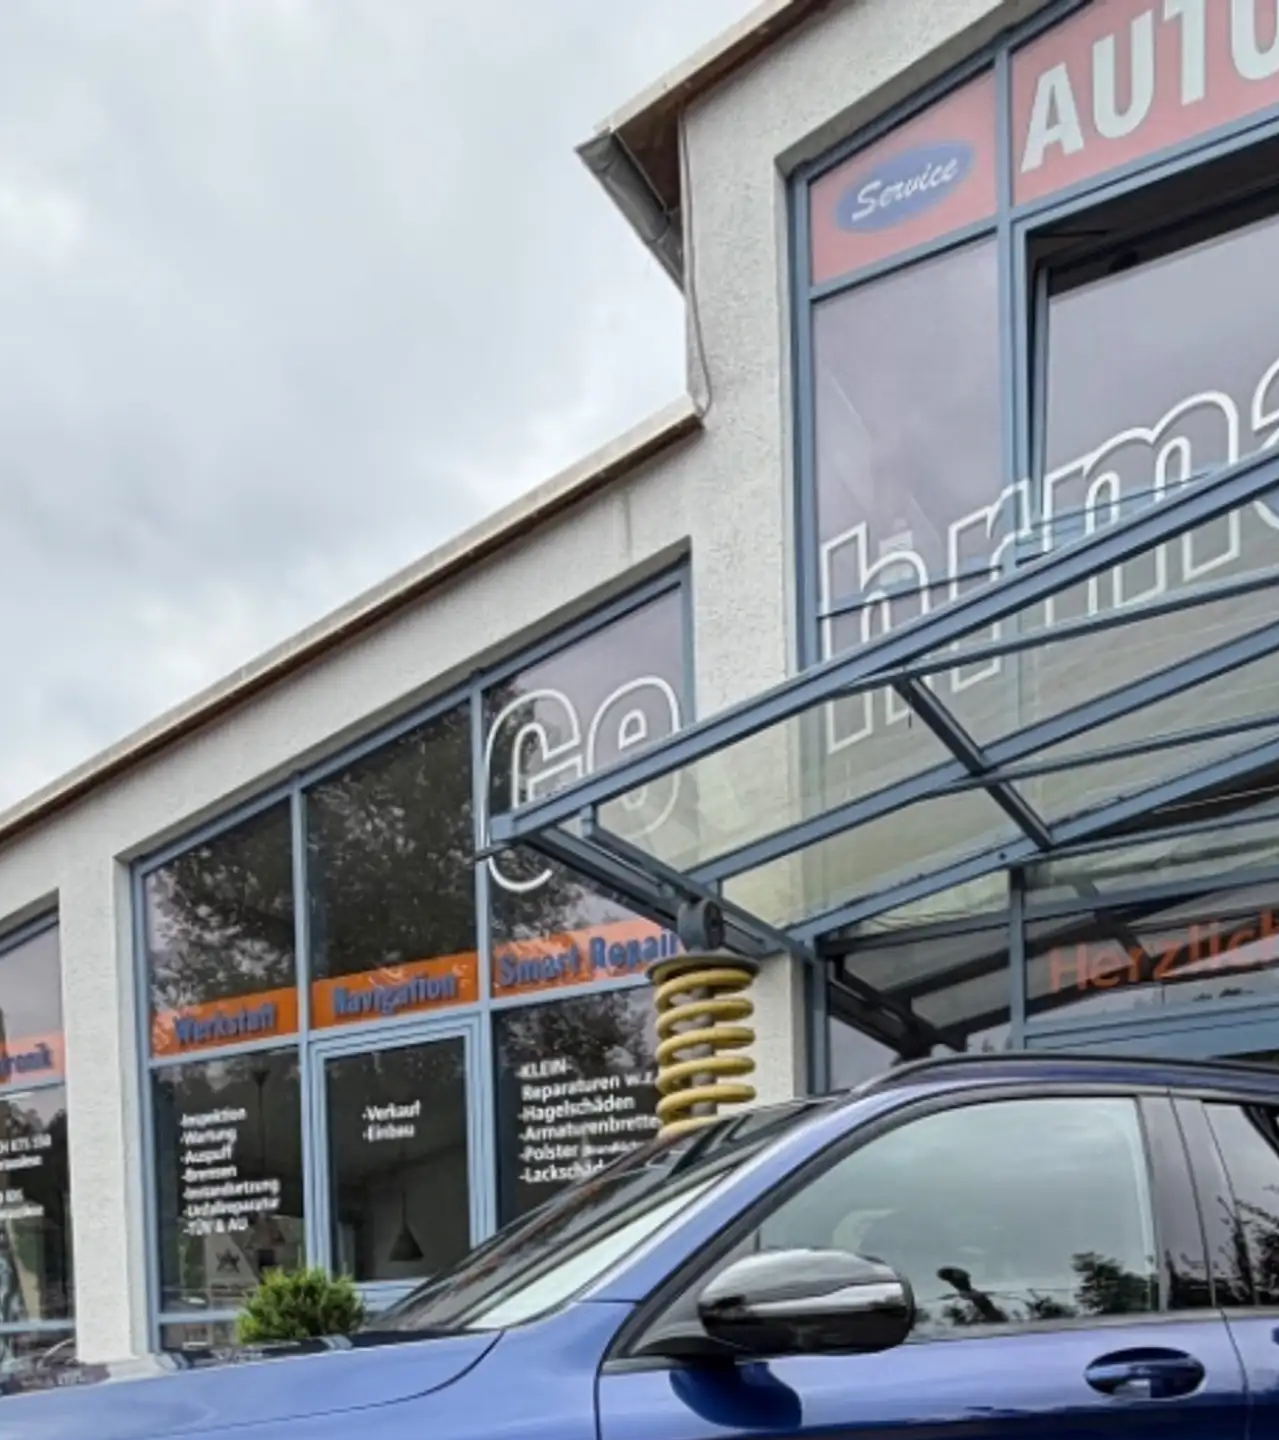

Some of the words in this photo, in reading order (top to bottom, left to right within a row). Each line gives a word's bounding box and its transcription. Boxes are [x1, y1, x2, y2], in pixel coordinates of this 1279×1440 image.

[851, 157, 959, 223] Service
[498, 944, 580, 987] Smart
[589, 932, 680, 973] Repair
[332, 974, 456, 1018] Navigation
[174, 1003, 275, 1045] Werkstatt
[522, 1075, 620, 1103] Reparaturen
[518, 1114, 662, 1140] -Armaturenbrette
